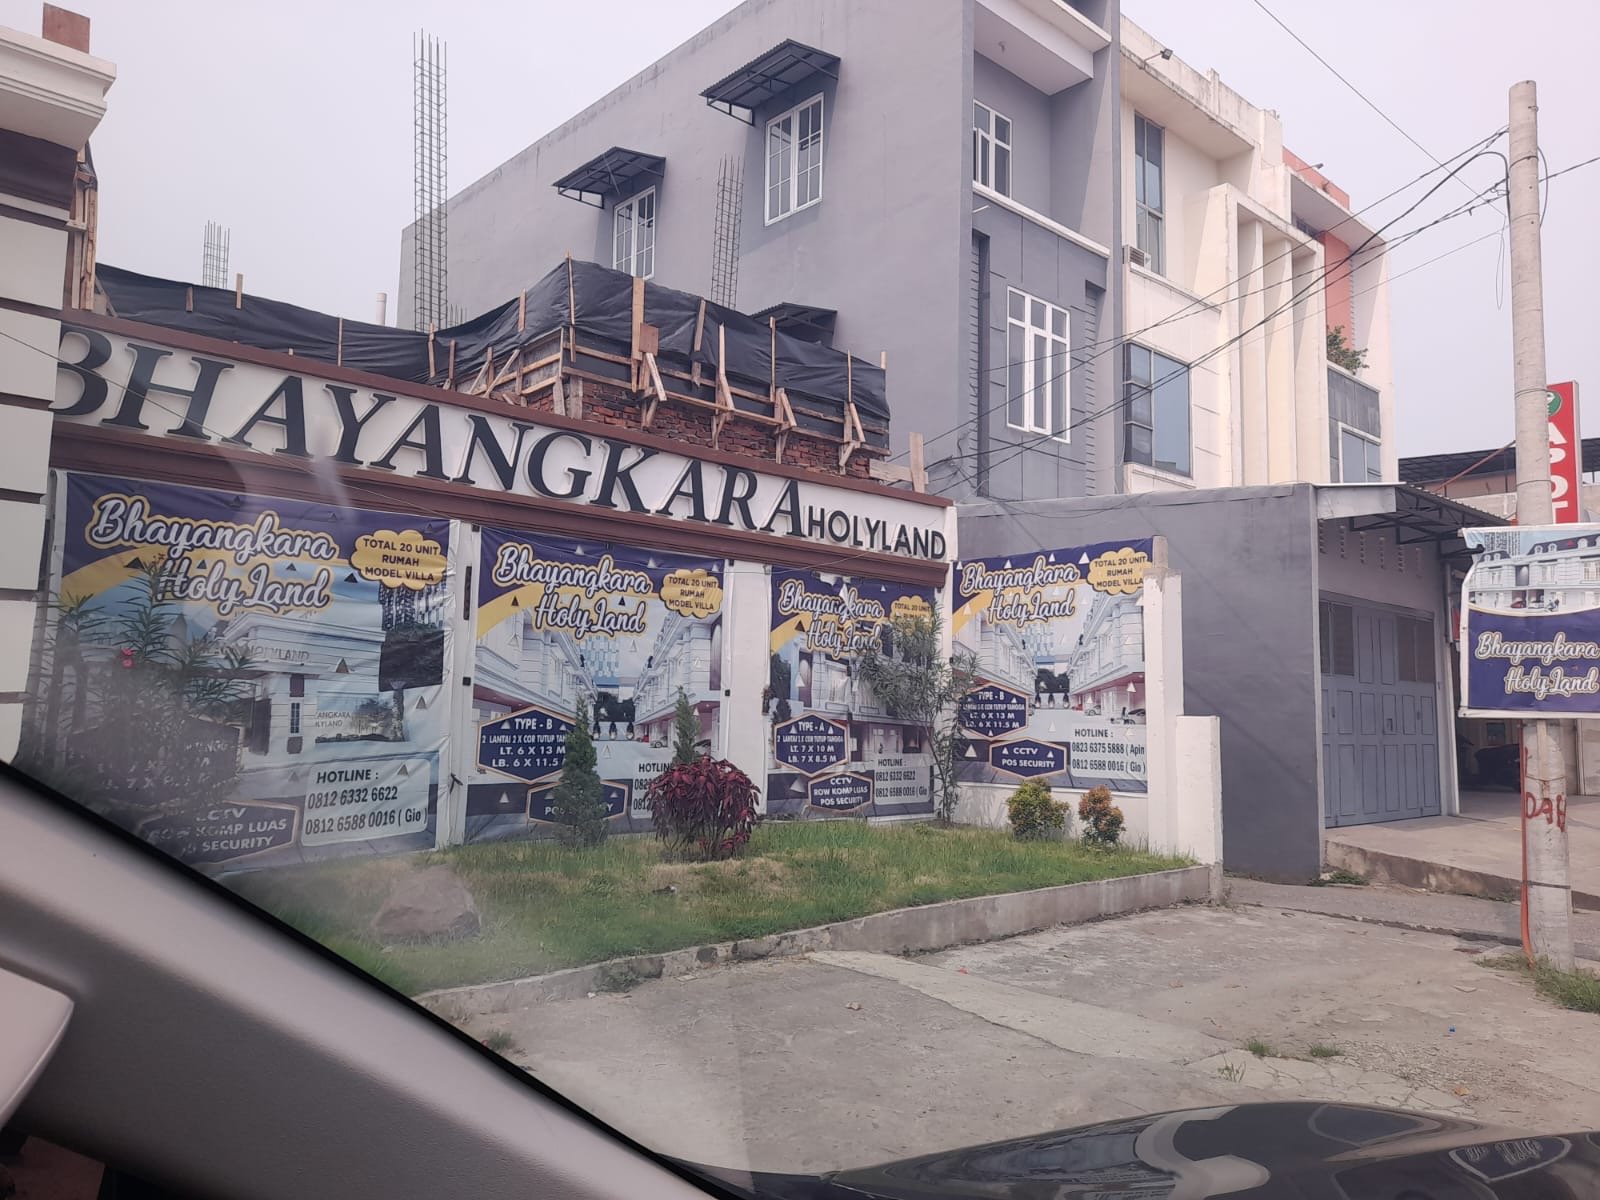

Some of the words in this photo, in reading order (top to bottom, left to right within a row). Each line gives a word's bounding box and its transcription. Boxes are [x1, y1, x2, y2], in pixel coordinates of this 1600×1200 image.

[49, 324, 807, 537] BHAYANGKARA
[807, 504, 947, 560] HOLYLAND
[90, 496, 337, 566] Bhayangkara
[363, 538, 397, 551] TOTAL
[399, 542, 413, 552] 20
[415, 544, 439, 555] UNIT
[382, 554, 419, 566] RUMAH
[1094, 559, 1117, 568] TOTAL
[1118, 558, 1127, 566] 20
[1129, 555, 1146, 564] UNIT
[364, 566, 402, 579] MODEL
[405, 571, 435, 581] VILLA
[495, 545, 652, 599] Bhayangkara
[961, 555, 1079, 596] Bhayangkara
[1107, 568, 1133, 576] RUMAH
[155, 557, 246, 615] Holy
[243, 563, 330, 614] Land
[668, 576, 690, 586] TOTAL
[701, 580, 717, 588] UNIT
[1123, 577, 1143, 586] VILLA
[680, 589, 705, 598] RUMAH
[668, 599, 693, 608] MODEL
[694, 601, 714, 610] VILLA
[779, 580, 885, 623] Bhayangkara
[988, 592, 1030, 628] Holy
[1028, 587, 1075, 623] Land
[534, 592, 591, 640] Holy
[589, 596, 647, 638] Land
[806, 617, 845, 657] Holy
[1476, 631, 1600, 665] Bhayangkara
[1504, 666, 1550, 700] Holy
[1548, 666, 1600, 698] Land
[978, 691, 993, 700] TYPE
[999, 691, 1005, 700] B
[514, 718, 537, 729] TYPE
[546, 718, 553, 729] B
[798, 721, 814, 731] TYPE
[819, 721, 825, 731] A
[489, 734, 511, 743] LANTAI
[1074, 728, 1108, 737] HOTLINE
[500, 746, 513, 755] LT.
[517, 746, 524, 755] 6
[528, 746, 536, 755] X
[540, 746, 553, 754] 13
[556, 745, 566, 754] M
[1013, 747, 1038, 755] CCTV
[1072, 741, 1088, 752] 0823
[492, 758, 509, 767] LB.
[513, 758, 520, 767] 6
[523, 758, 532, 767] X
[535, 758, 559, 767] 11.5
[638, 762, 671, 773] HOTLIN
[878, 758, 903, 766] HOTLINE
[1002, 758, 1018, 766] POS
[1019, 759, 1056, 768] SECURITY
[1072, 758, 1088, 769] 0812
[316, 769, 372, 784] HOTLINE
[830, 777, 853, 785] CCTV
[307, 790, 338, 809] 0812
[340, 787, 369, 806] 6332
[371, 786, 398, 801] 6622
[814, 788, 831, 796] ROW
[248, 818, 287, 833] LUAS
[305, 818, 334, 835] 0812
[337, 813, 366, 832] 6588
[368, 810, 396, 828] 0016
[405, 808, 421, 823] Gio
[202, 836, 274, 851] SECURITY
